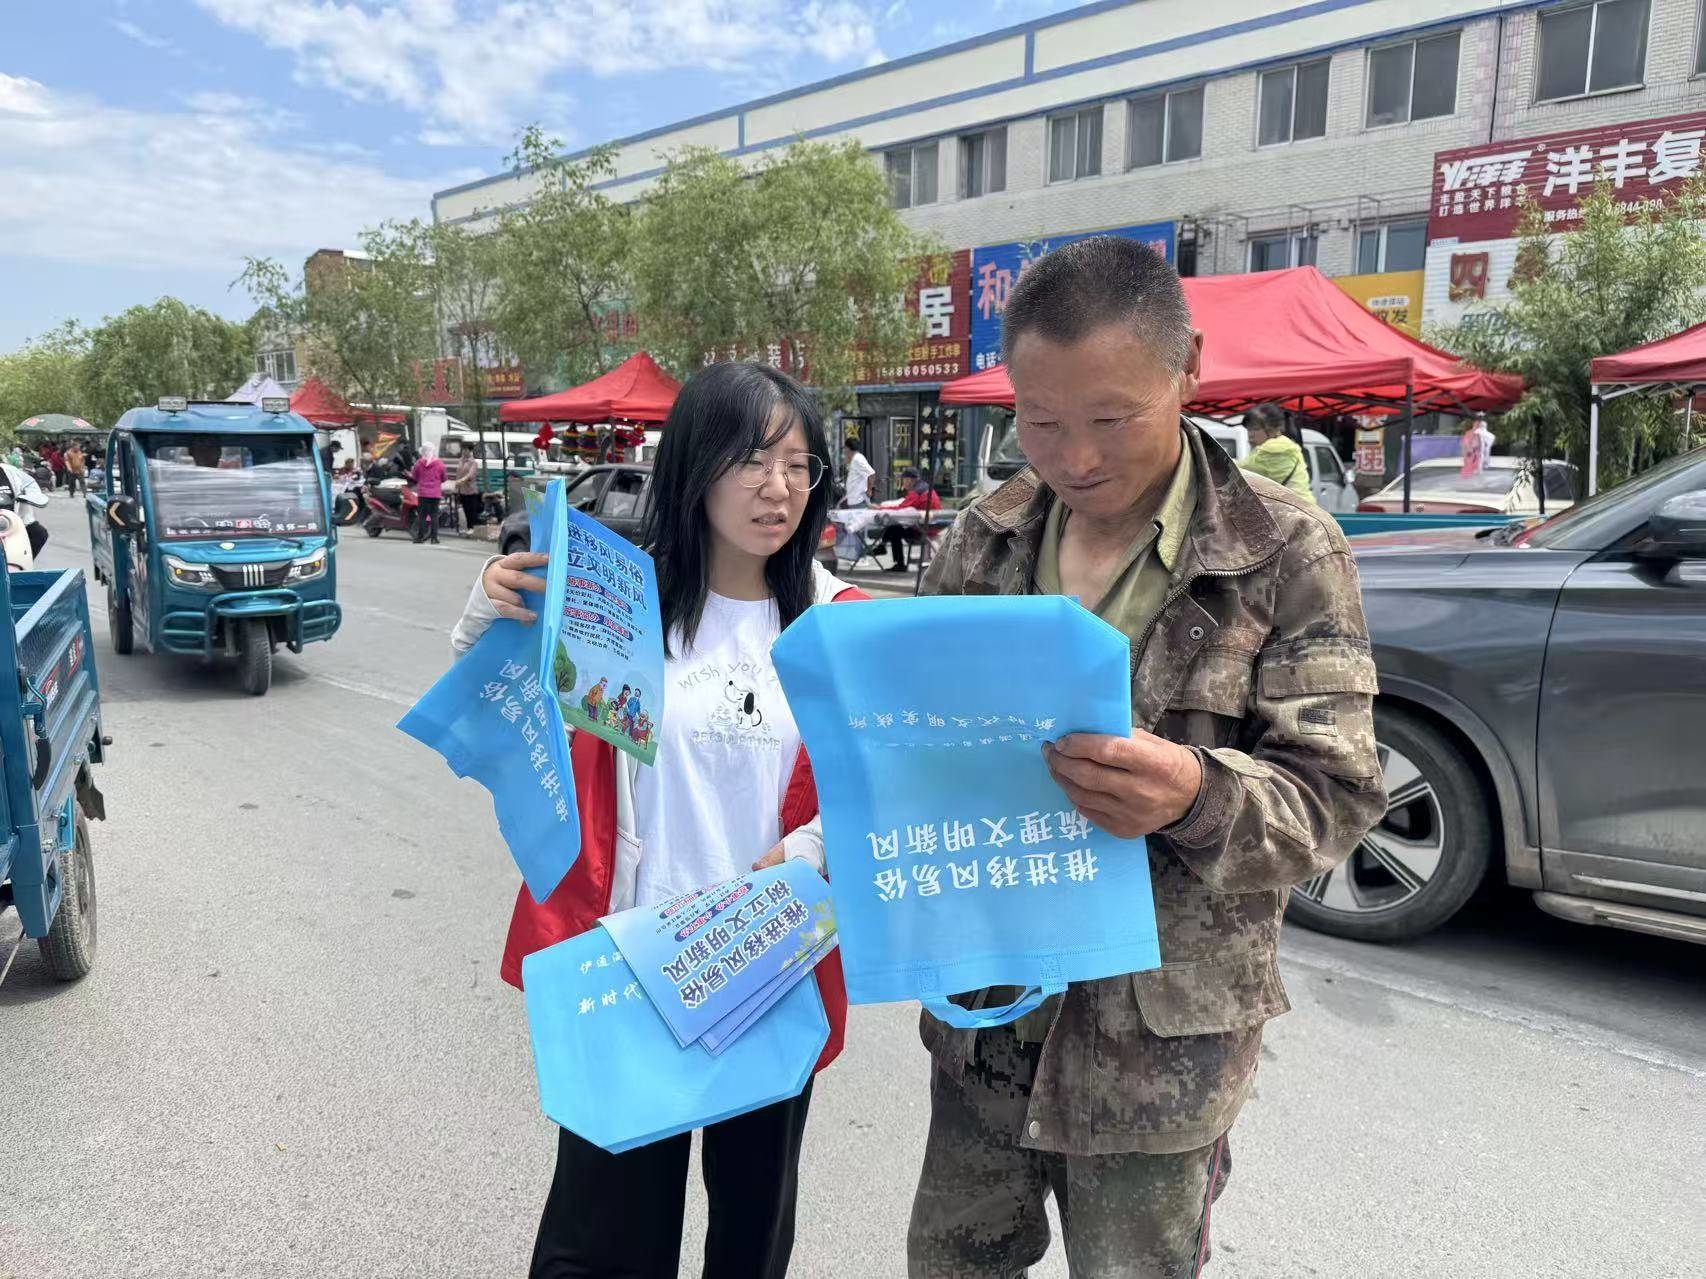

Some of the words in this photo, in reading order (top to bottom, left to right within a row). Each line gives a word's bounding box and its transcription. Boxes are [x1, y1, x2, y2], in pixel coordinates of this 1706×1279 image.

[1543, 131, 1706, 197] 洋丰复
[500, 659, 549, 735] 明新风
[866, 809, 1094, 861] 梳理文明新风
[873, 848, 1099, 902] 推进移风易俗
[662, 878, 793, 985] 树立文明新风
[677, 898, 808, 1008] 推进移风易俗
[578, 982, 642, 1015] 新时代
